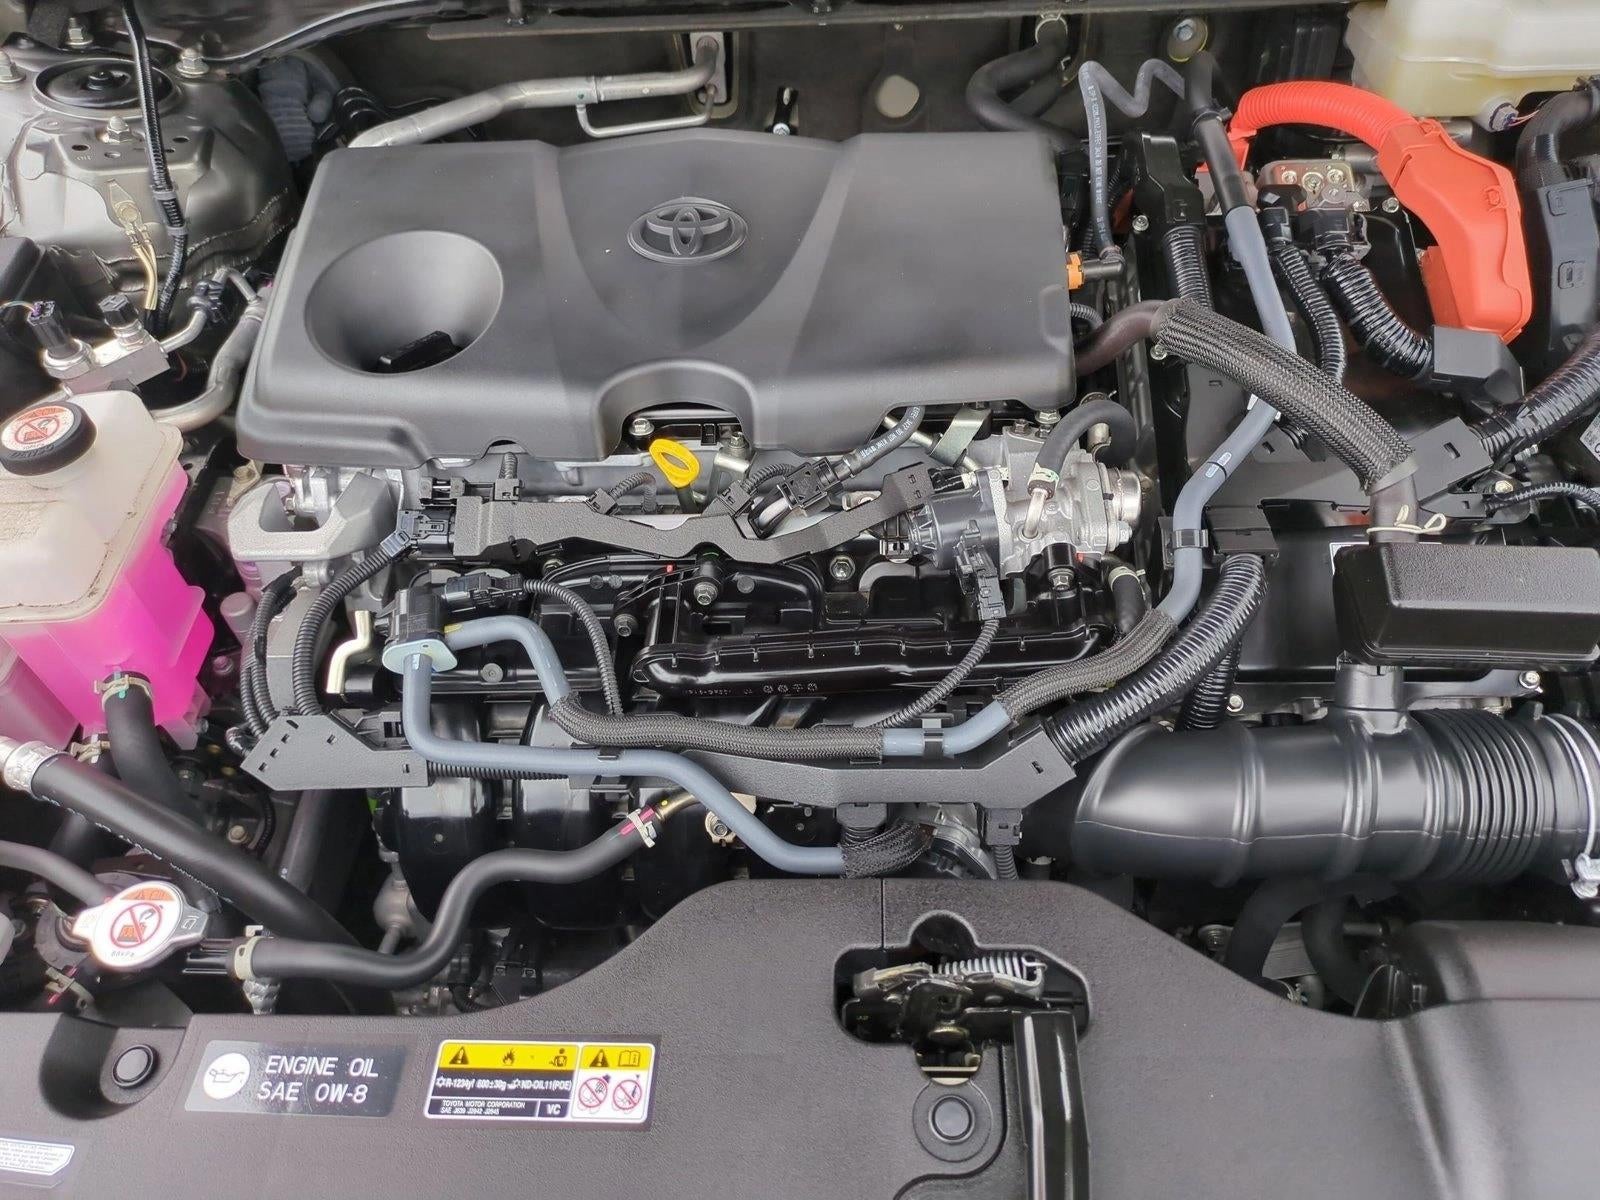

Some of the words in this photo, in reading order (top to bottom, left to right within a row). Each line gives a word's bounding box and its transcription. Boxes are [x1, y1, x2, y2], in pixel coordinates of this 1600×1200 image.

[265, 1055, 338, 1075] ENGINE
[350, 1058, 379, 1077] OIL
[257, 1081, 302, 1101] SAE
[315, 1083, 369, 1104] 0W-8
[487, 1101, 526, 1109] CORPORATION
[546, 1104, 561, 1115] VC
